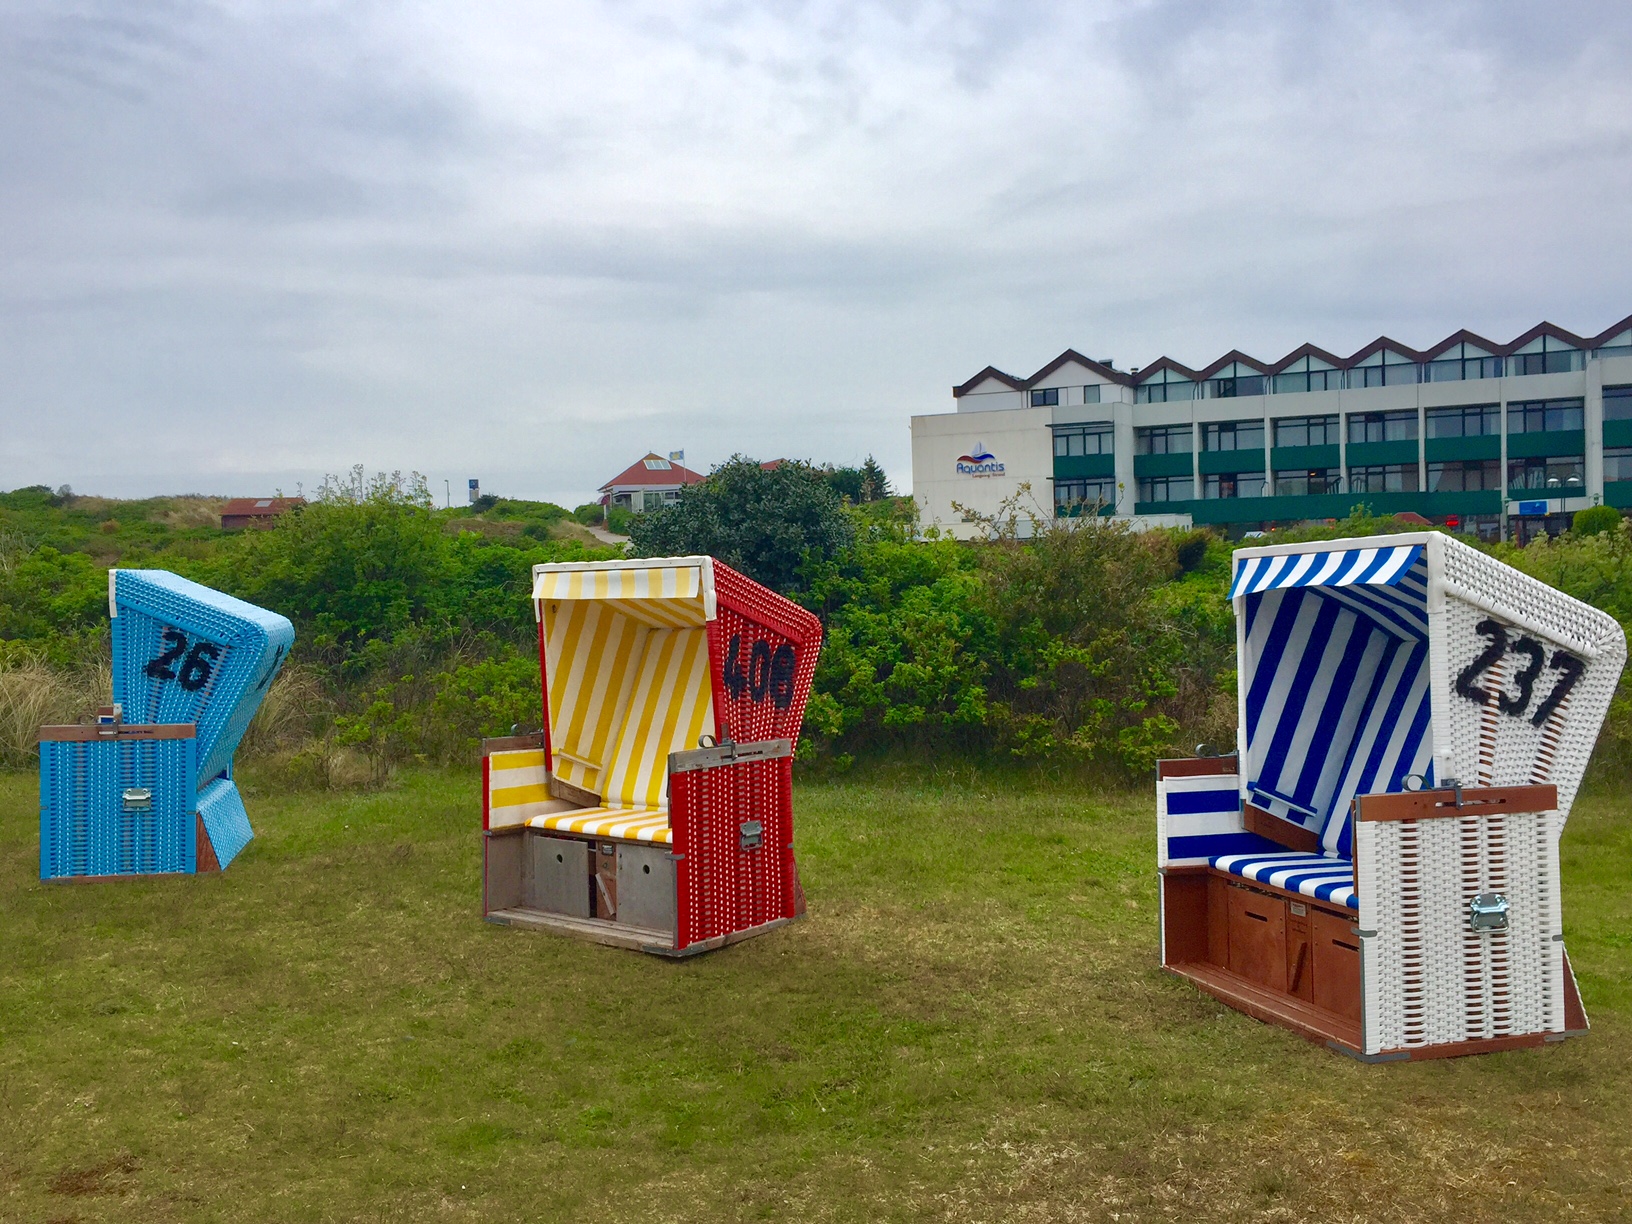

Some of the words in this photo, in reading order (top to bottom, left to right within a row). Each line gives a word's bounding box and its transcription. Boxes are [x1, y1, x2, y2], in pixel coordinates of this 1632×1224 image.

[956, 462, 1005, 474] Aquantis
[144, 630, 222, 692] 26
[723, 633, 796, 709] 408
[1455, 619, 1586, 728] 237
